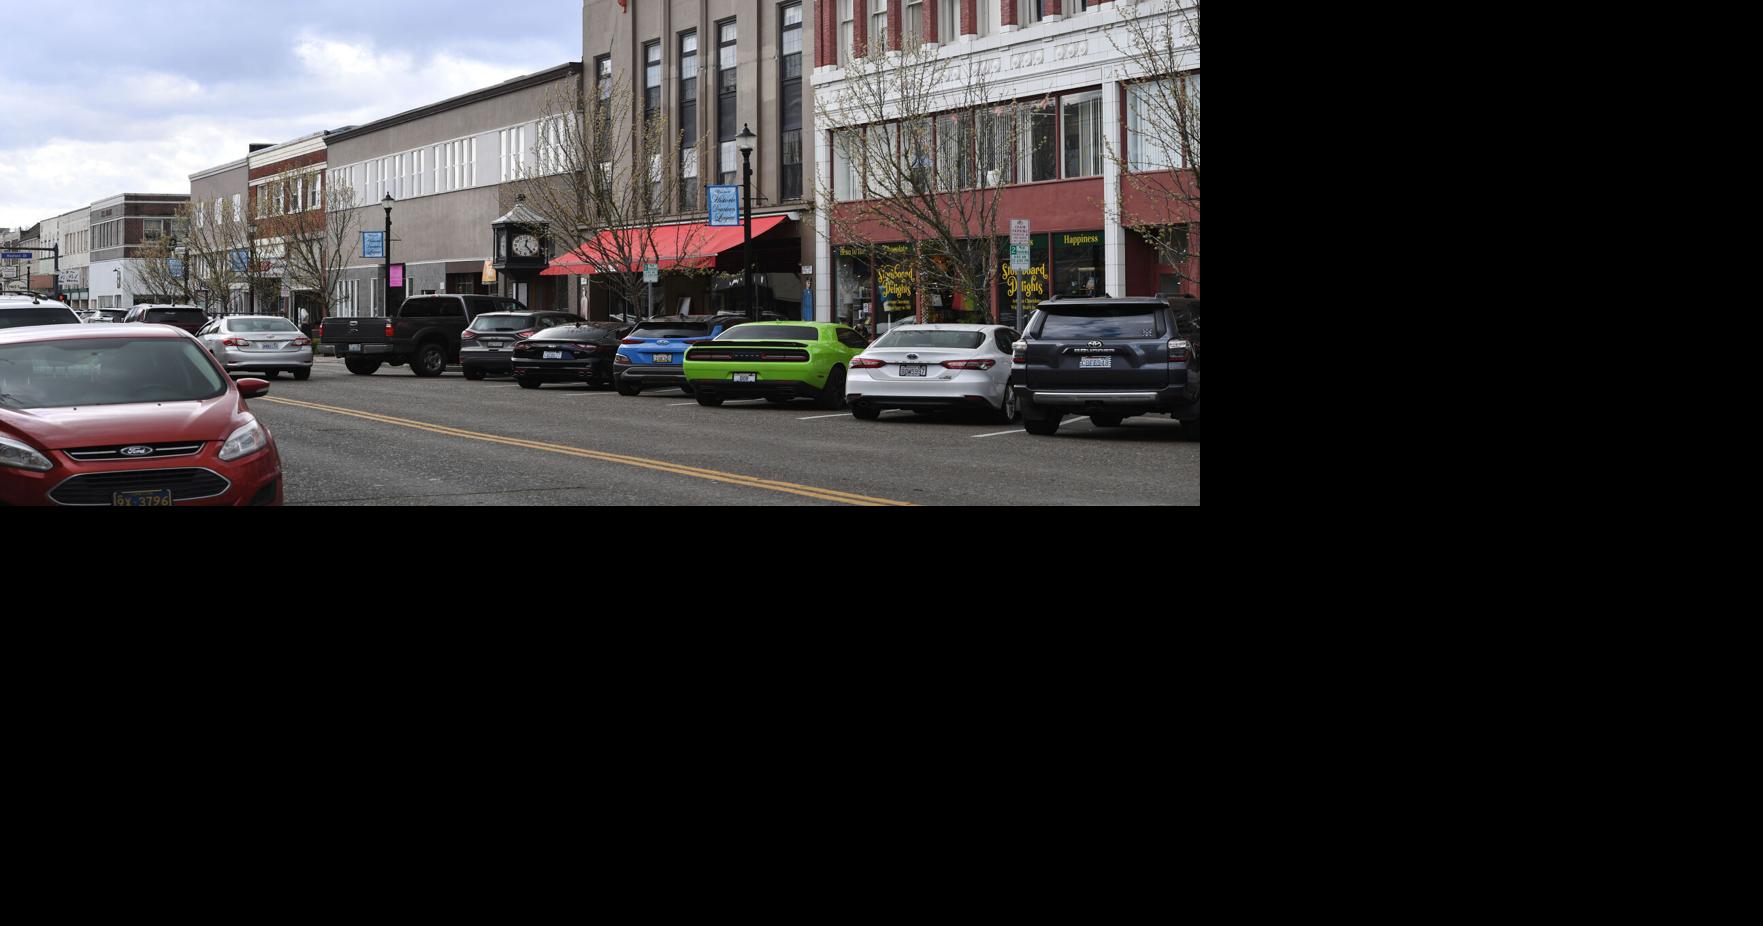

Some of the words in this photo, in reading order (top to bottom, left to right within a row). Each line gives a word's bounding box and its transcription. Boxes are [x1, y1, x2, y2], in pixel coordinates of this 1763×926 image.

[1063, 234, 1099, 246] Happiness
[1007, 275, 1044, 297] Dlights
[126, 446, 146, 454] Ford
[138, 495, 169, 506] 3796
